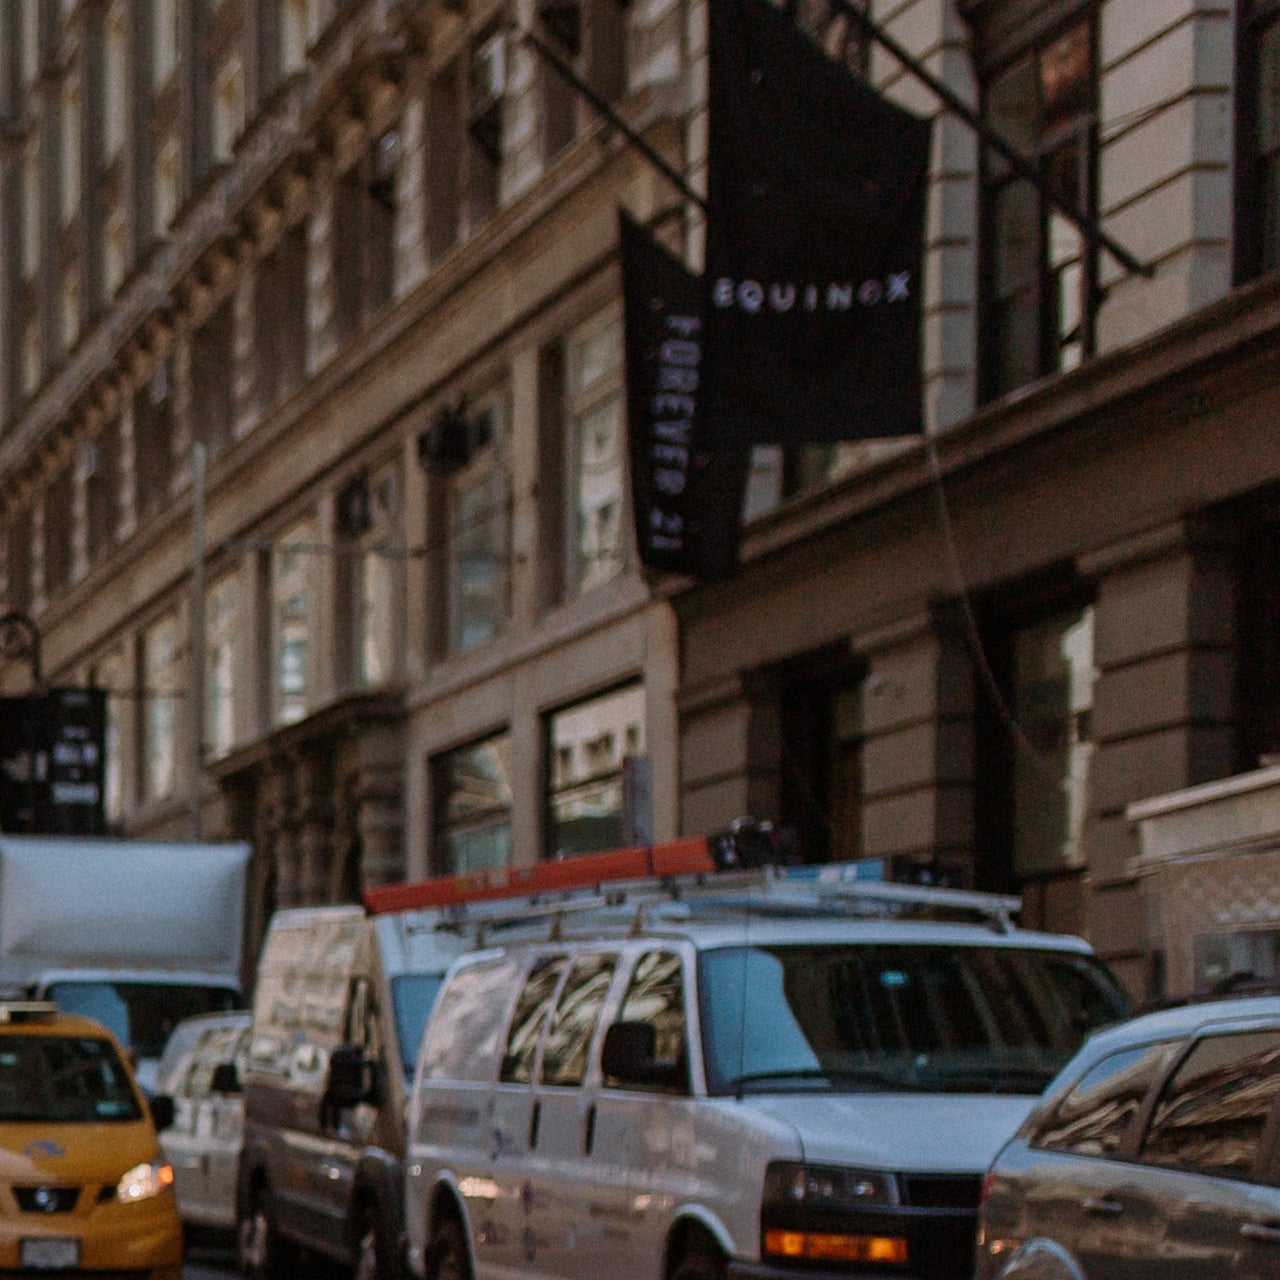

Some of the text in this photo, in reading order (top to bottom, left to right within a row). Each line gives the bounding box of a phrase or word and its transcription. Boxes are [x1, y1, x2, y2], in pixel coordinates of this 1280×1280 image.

[713, 271, 911, 313] EQUINOX
[649, 314, 702, 549] FOREVER 21
